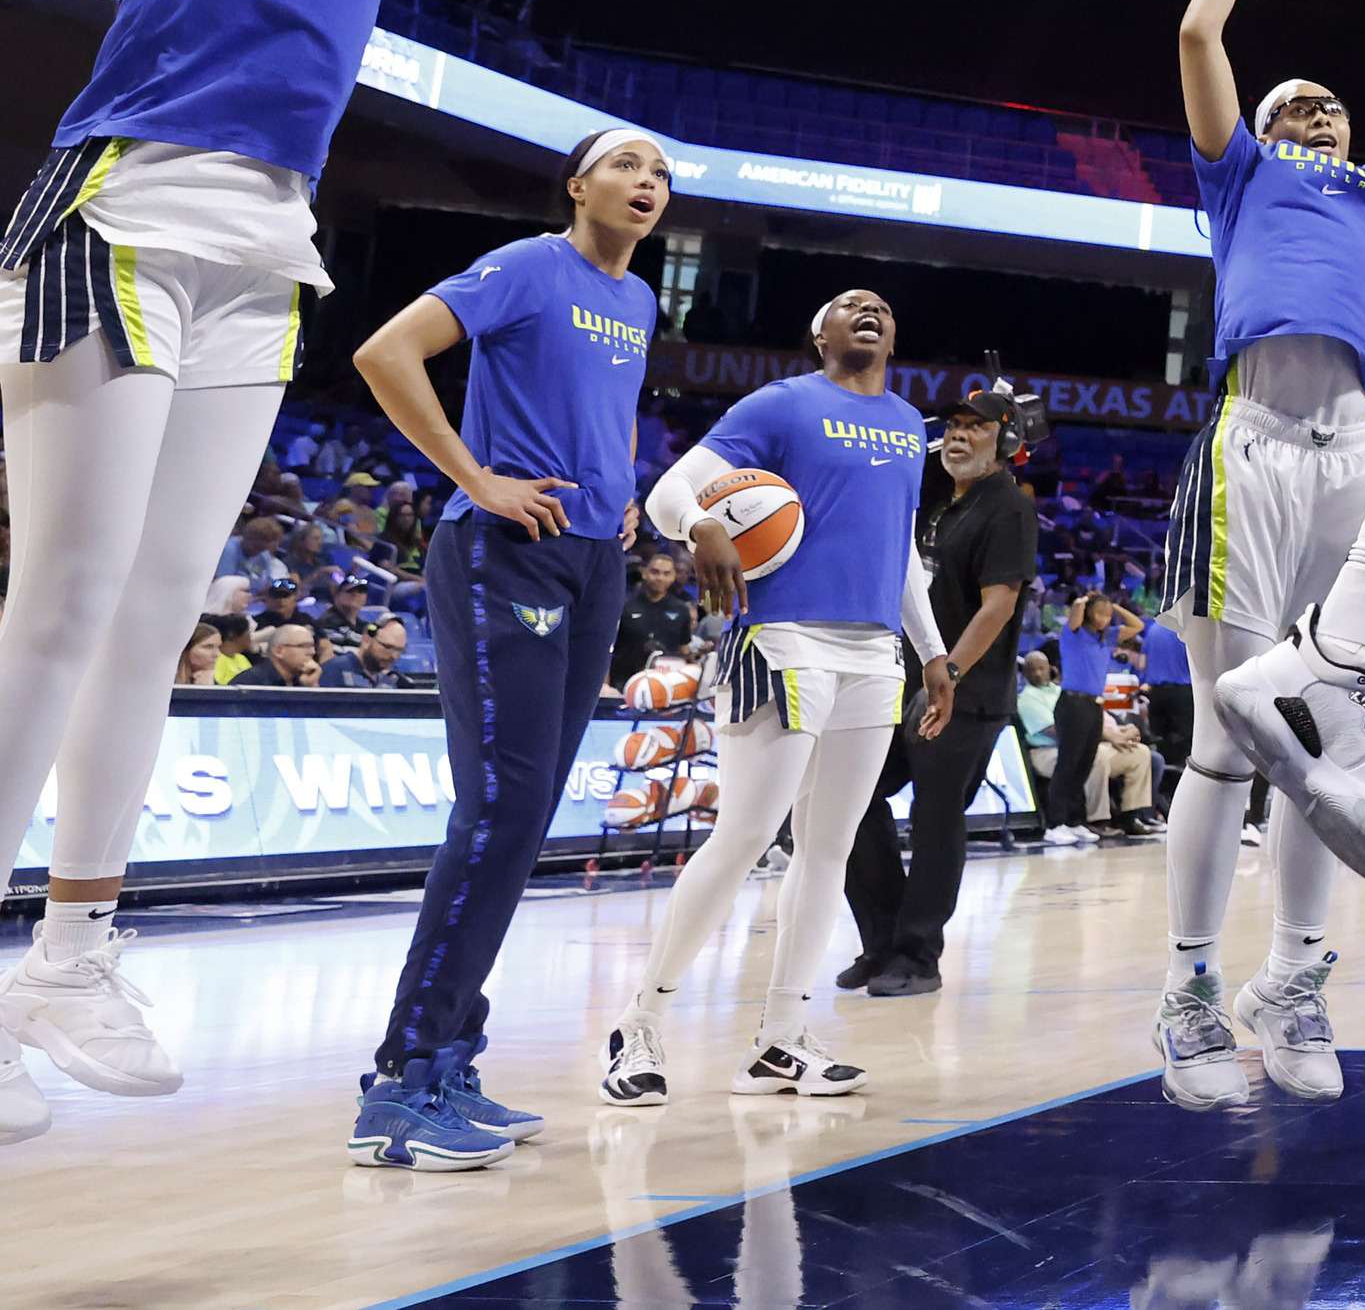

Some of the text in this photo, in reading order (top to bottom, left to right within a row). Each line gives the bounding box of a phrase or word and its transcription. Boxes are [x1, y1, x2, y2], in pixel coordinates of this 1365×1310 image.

[737, 161, 835, 190] AMERICAN
[836, 173, 912, 199] FIDELITY
[572, 304, 648, 350] WINGS
[684, 349, 949, 403] UNIVITY
[1022, 377, 1153, 420] TEXAS
[822, 418, 921, 454] WINGS
[843, 439, 915, 459] DALLAS
